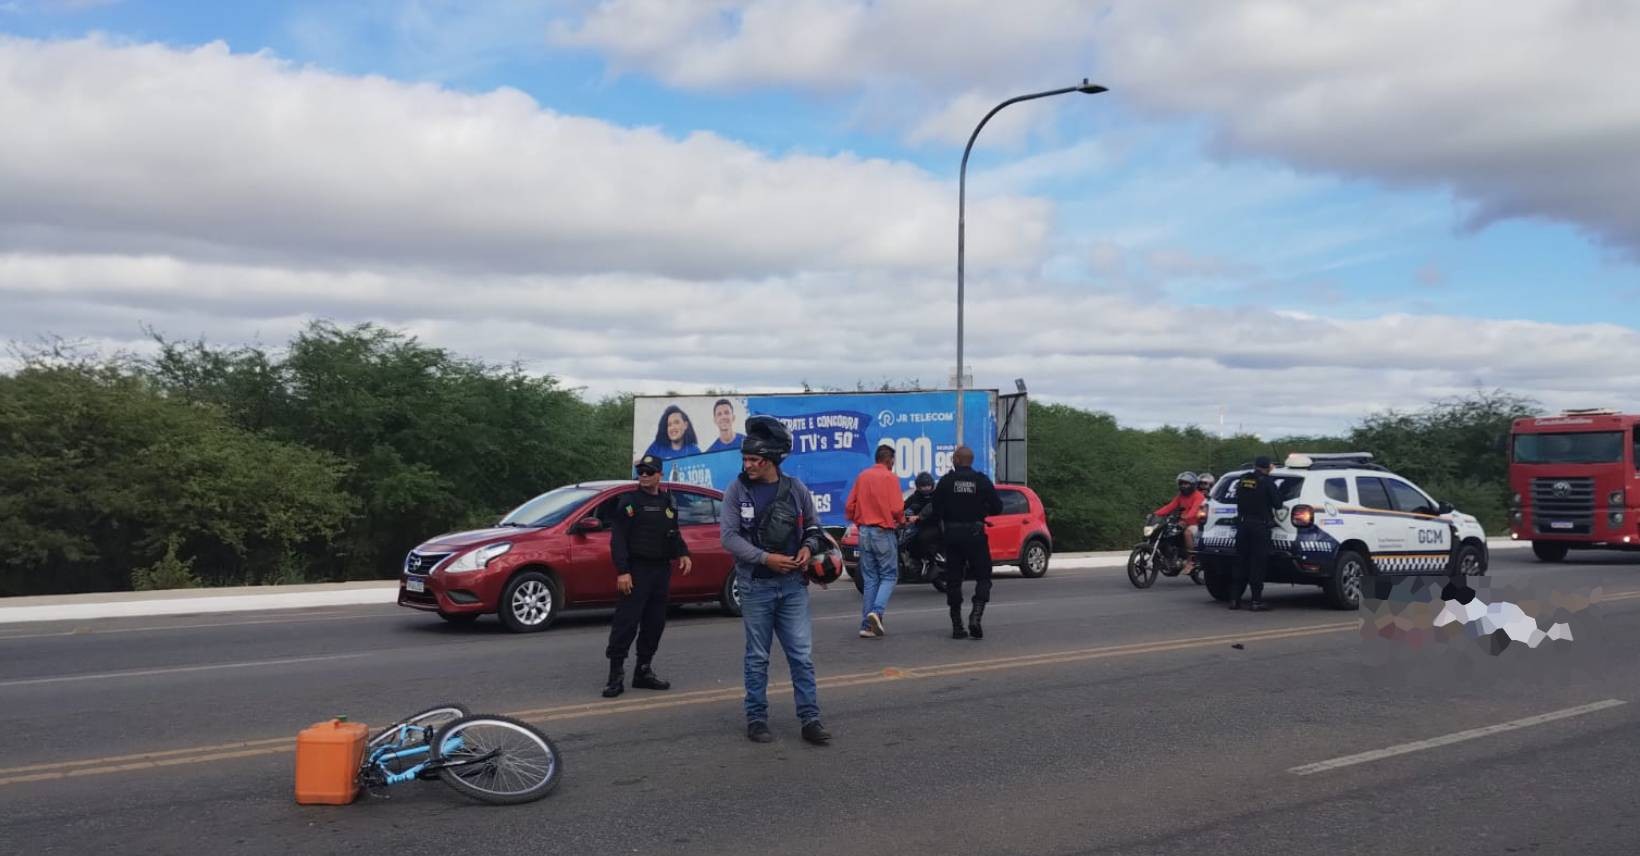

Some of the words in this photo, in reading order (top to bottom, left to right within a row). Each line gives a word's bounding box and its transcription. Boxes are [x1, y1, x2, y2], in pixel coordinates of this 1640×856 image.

[817, 415, 859, 430] CONCORRA
[910, 412, 954, 423] TELECOM
[811, 491, 831, 512] ES
[1418, 529, 1443, 544] GCM
